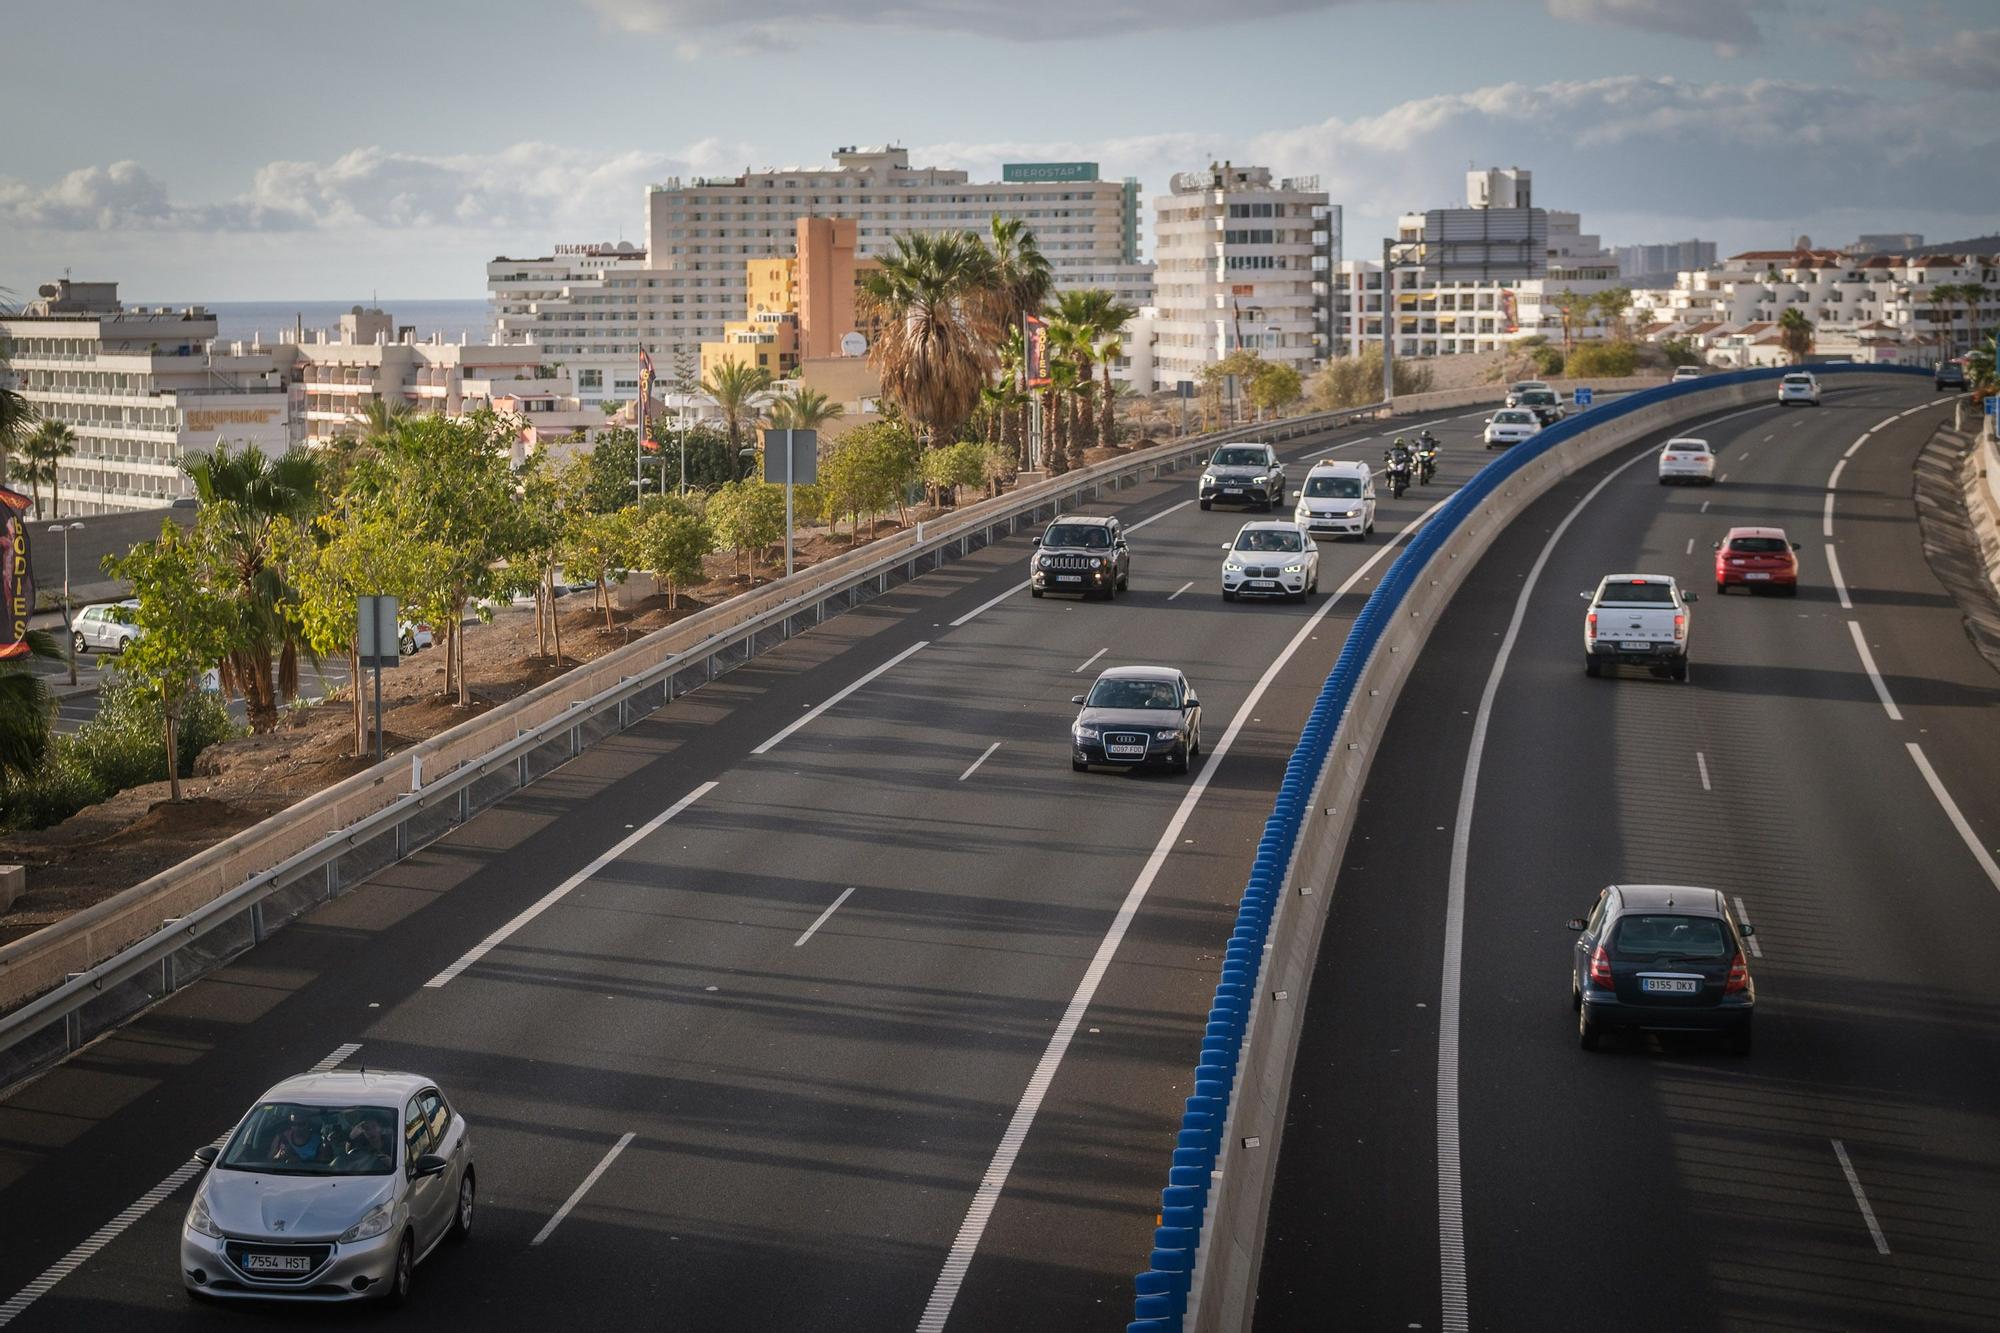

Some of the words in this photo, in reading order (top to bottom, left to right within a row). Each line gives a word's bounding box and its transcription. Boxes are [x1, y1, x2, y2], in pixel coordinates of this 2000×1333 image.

[1011, 167, 1076, 178] IBEROSTAR
[1039, 327, 1047, 378] BODIES
[187, 408, 269, 424] SUNPRIME
[1649, 980, 1672, 990] 9155
[1676, 981, 1694, 991] DKX
[251, 1255, 279, 1268] 7554
[285, 1257, 306, 1269] HST
